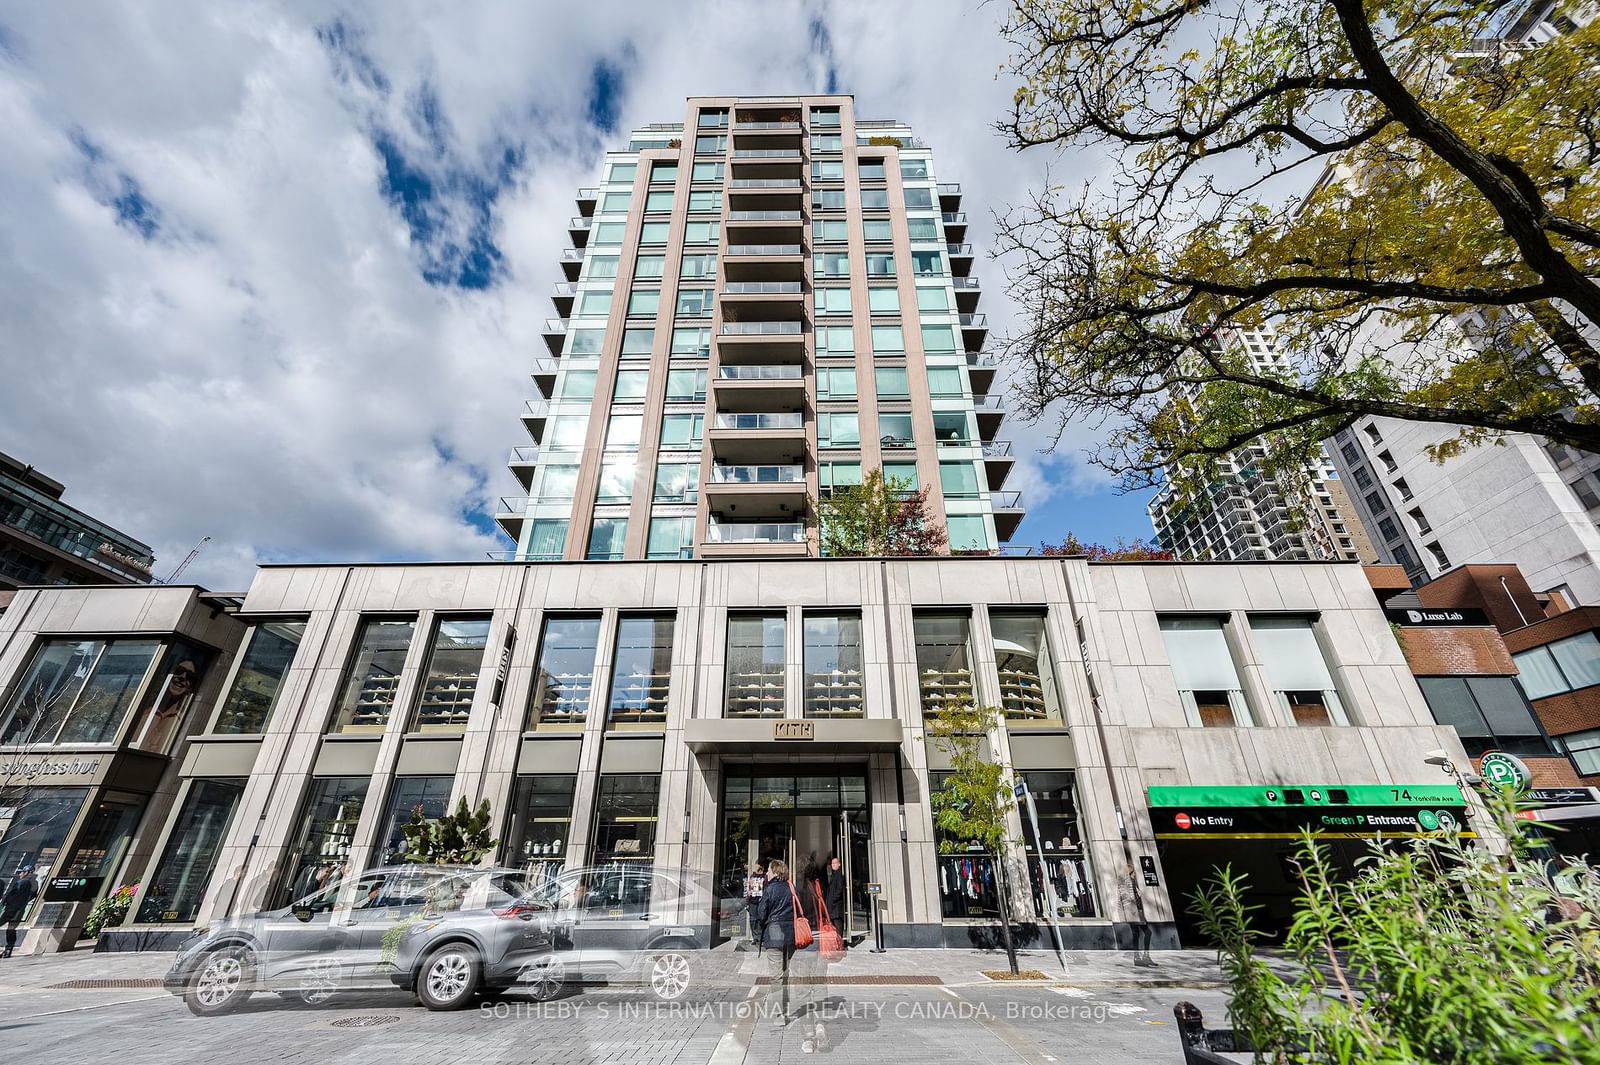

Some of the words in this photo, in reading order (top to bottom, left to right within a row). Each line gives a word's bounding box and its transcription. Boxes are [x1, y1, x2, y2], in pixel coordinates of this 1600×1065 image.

[1422, 612, 1445, 620] Luxe
[1445, 612, 1463, 620] Lab
[497, 646, 510, 682] KITH
[775, 723, 811, 736] KITH
[69, 758, 99, 775] hut
[1391, 789, 1412, 802] 74
[1192, 816, 1206, 825] No
[1208, 816, 1233, 827] Entry
[1321, 815, 1355, 825] Green
[1358, 815, 1365, 825] P
[1366, 815, 1417, 825] Entrance
